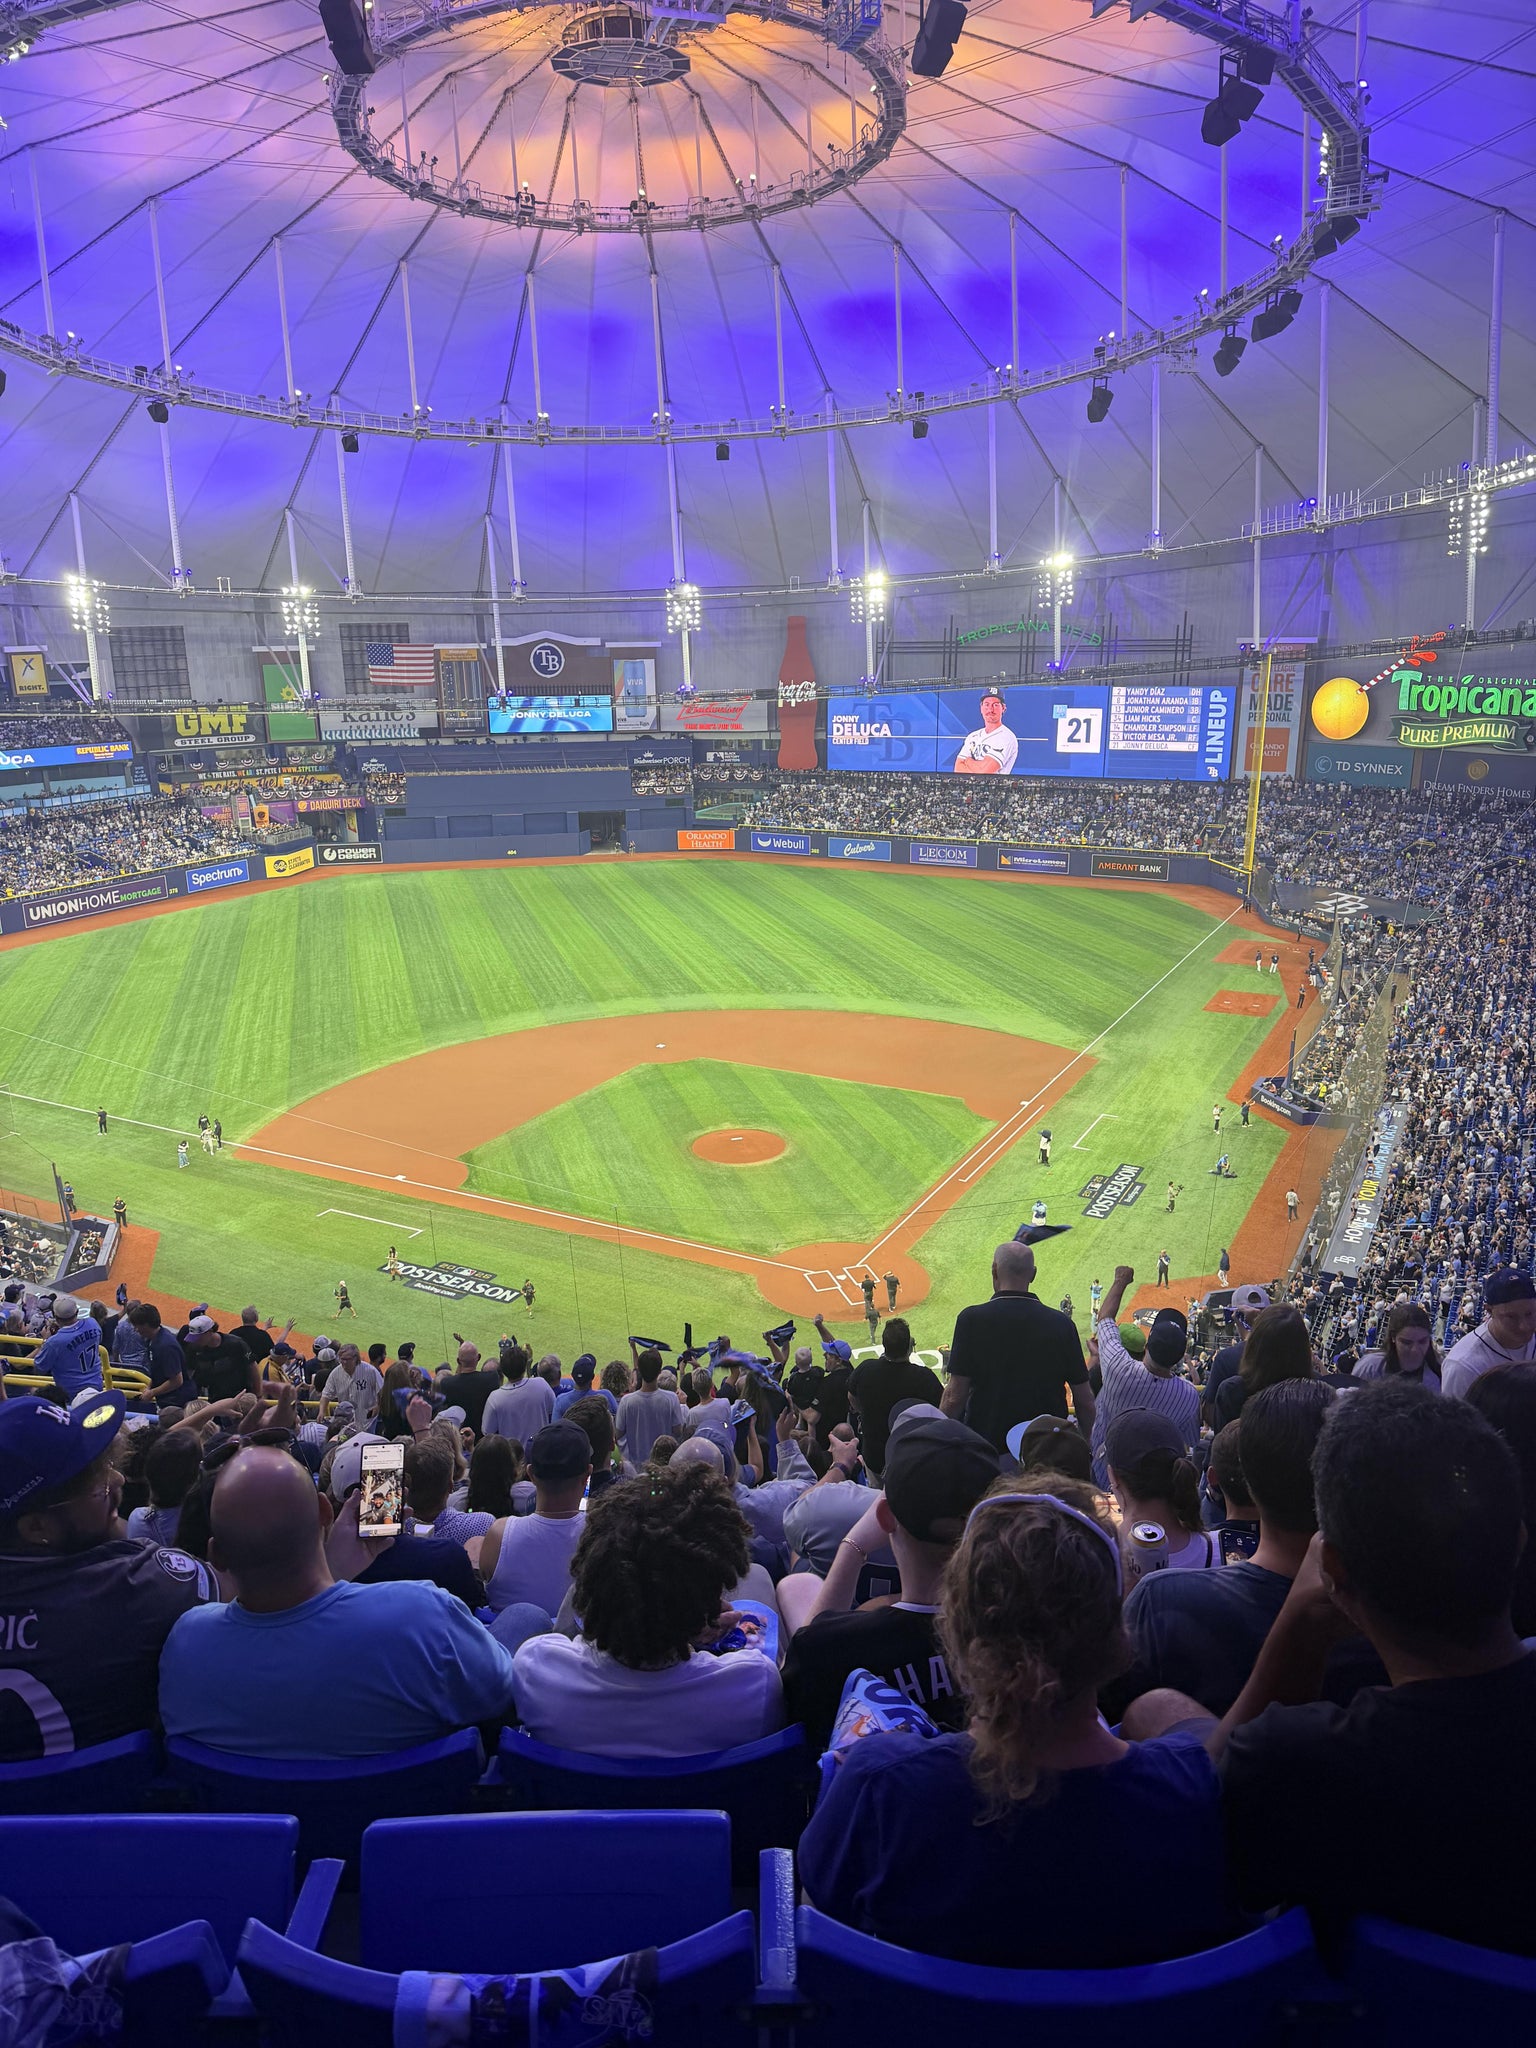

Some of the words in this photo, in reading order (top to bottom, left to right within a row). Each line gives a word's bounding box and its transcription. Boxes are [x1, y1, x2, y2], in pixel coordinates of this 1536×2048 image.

[957, 620, 1050, 647] TROPICANA
[19, 684, 45, 692] RIGHT.
[627, 678, 643, 686] VIVA
[1478, 677, 1536, 686] ORIGINAL
[1126, 697, 1160, 705] JONATHAN
[1161, 697, 1188, 705] ARANDA
[1391, 670, 1536, 718] Tropicana
[1125, 706, 1149, 714] JUNIOR
[1150, 706, 1185, 714] CAMINERO
[175, 705, 249, 737] GMF
[832, 715, 859, 723] JONNY
[1205, 689, 1227, 763] LINEUP
[832, 723, 892, 737] DELUCA
[1067, 718, 1092, 743] 21
[1124, 724, 1157, 732] CHANDLER
[1158, 724, 1187, 732] SIMPSON
[1400, 724, 1440, 743] PURE
[1442, 723, 1516, 742] PREMIUM
[180, 737, 214, 746] STEEL
[217, 735, 251, 744] GROUP
[76, 746, 109, 754] REPUBLIC
[1336, 761, 1351, 771] TD
[1354, 762, 1403, 775] SYNNEX
[1424, 780, 1455, 793] DREAM
[1457, 783, 1495, 796] FINDERS
[1497, 786, 1532, 798] HOMES
[310, 800, 342, 810] DAIQUIRI
[343, 798, 362, 808] DECK
[691, 840, 723, 848] HEALTH
[773, 838, 805, 849] Webull
[844, 842, 876, 857] Culver's
[1013, 856, 1067, 865] MicroLumen
[1098, 862, 1138, 871] AMERANT
[1139, 865, 1162, 873] BANK
[191, 866, 239, 886] Spectrum
[120, 886, 162, 902] MORTGAGE
[1086, 1164, 1140, 1218] POSTSEASON
[1343, 1218, 1367, 1244] HOME
[1358, 1179, 1380, 1202] YOUR
[382, 1261, 521, 1302] POSTSEASON
[79, 1344, 96, 1374] 17
